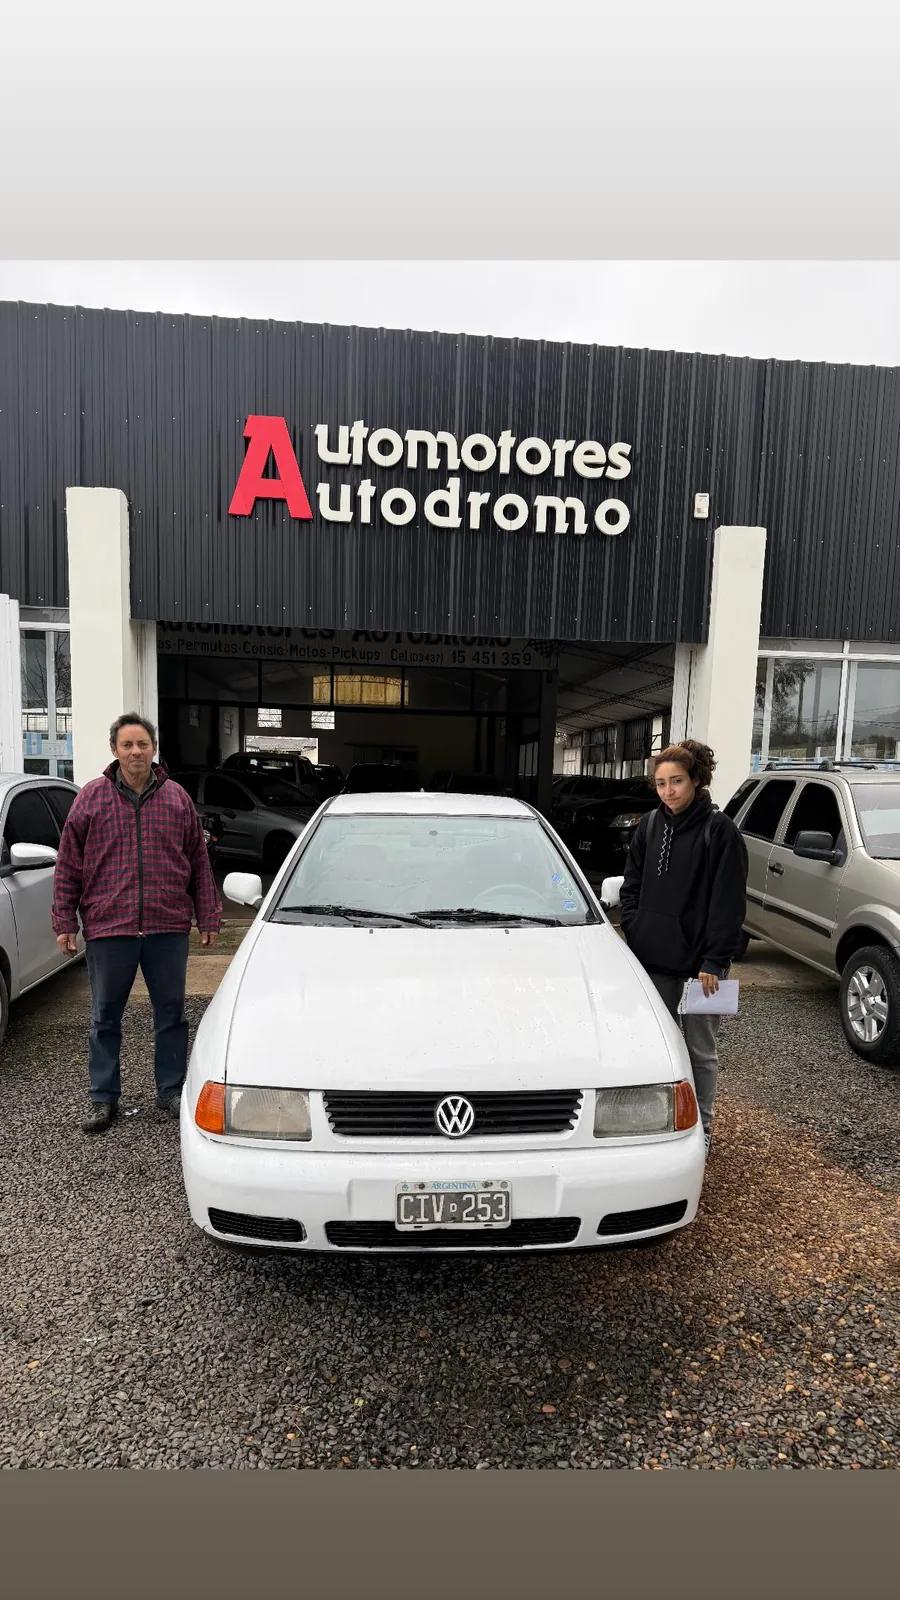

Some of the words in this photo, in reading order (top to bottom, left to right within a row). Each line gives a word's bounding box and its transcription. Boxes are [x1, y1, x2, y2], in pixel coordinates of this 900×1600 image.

[332, 646, 381, 662] Pickups
[451, 650, 466, 664] 15
[471, 651, 496, 665] 451
[501, 652, 532, 666] 359
[431, 1181, 477, 1190] ARGENTINA
[400, 1194, 444, 1223] CIV
[462, 1193, 507, 1221] 253
